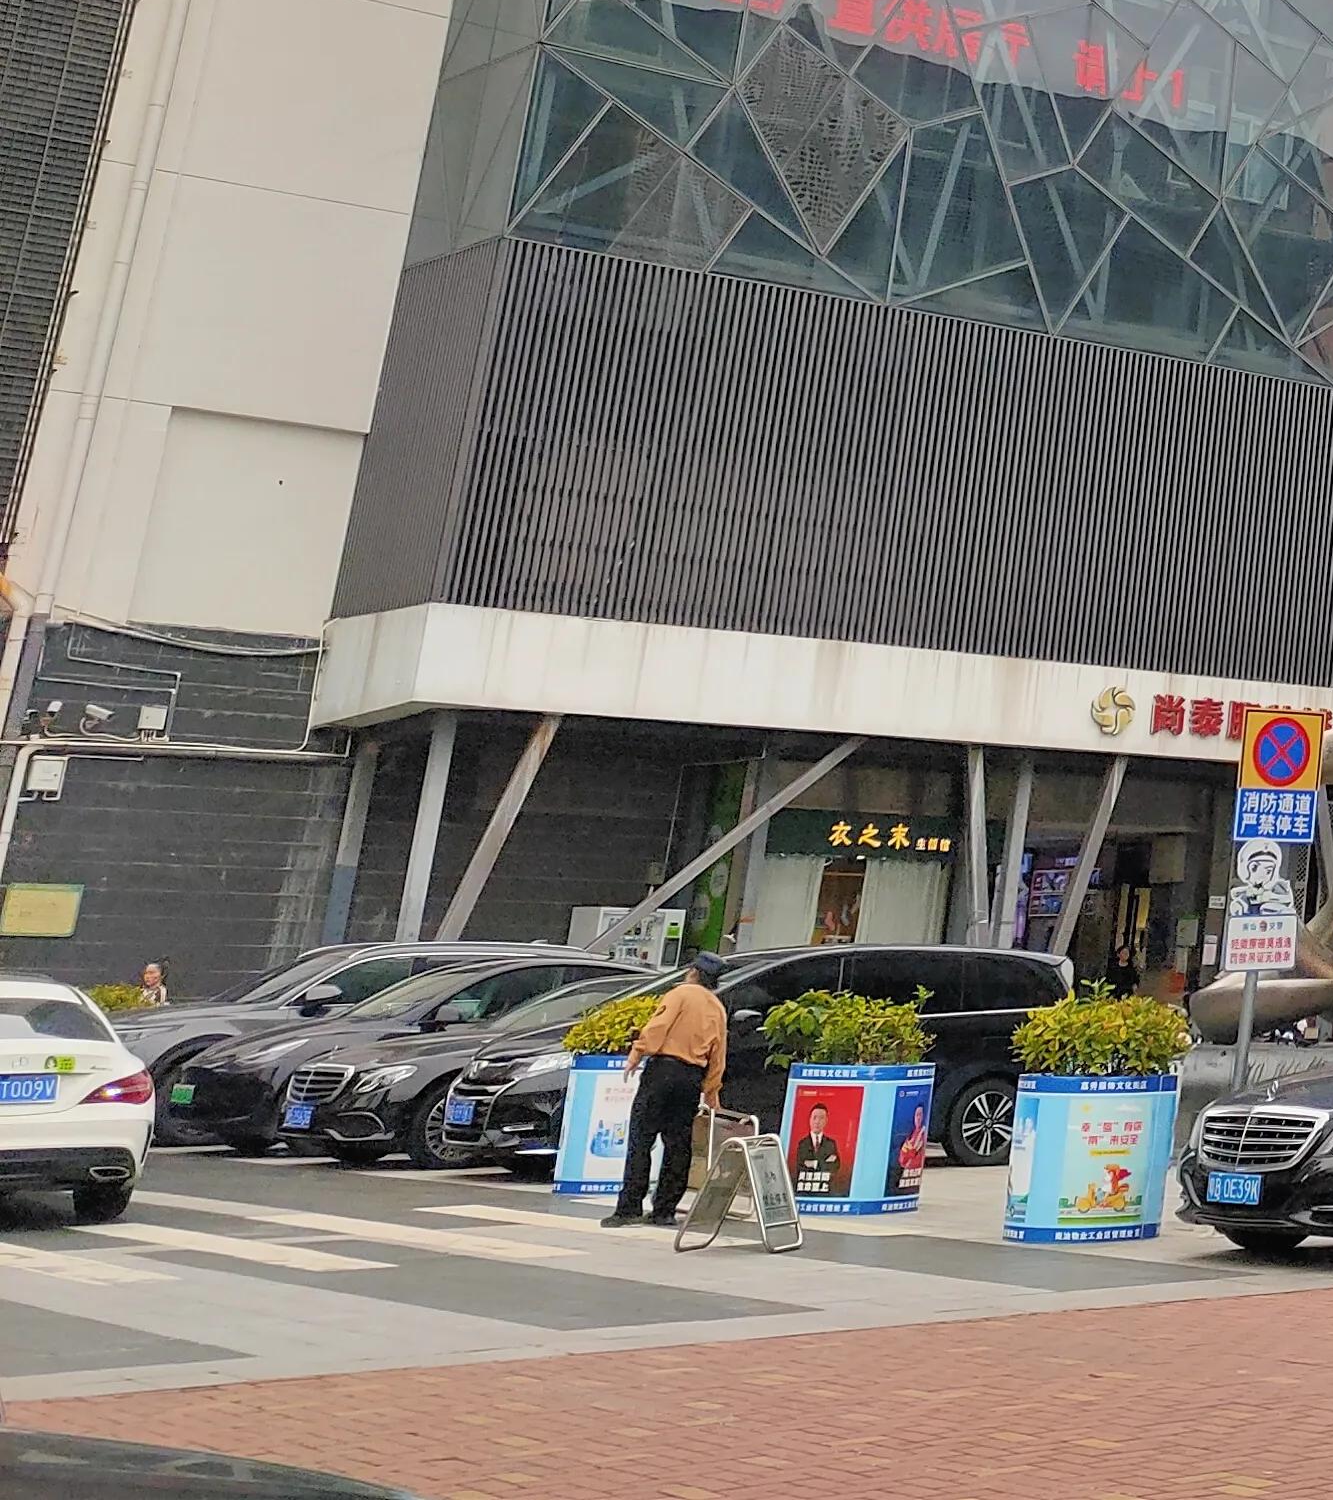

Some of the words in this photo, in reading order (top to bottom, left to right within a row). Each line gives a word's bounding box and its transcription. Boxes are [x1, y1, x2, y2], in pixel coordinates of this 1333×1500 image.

[1242, 791, 1312, 816] 消防通道
[1240, 813, 1310, 837] 严禁停车
